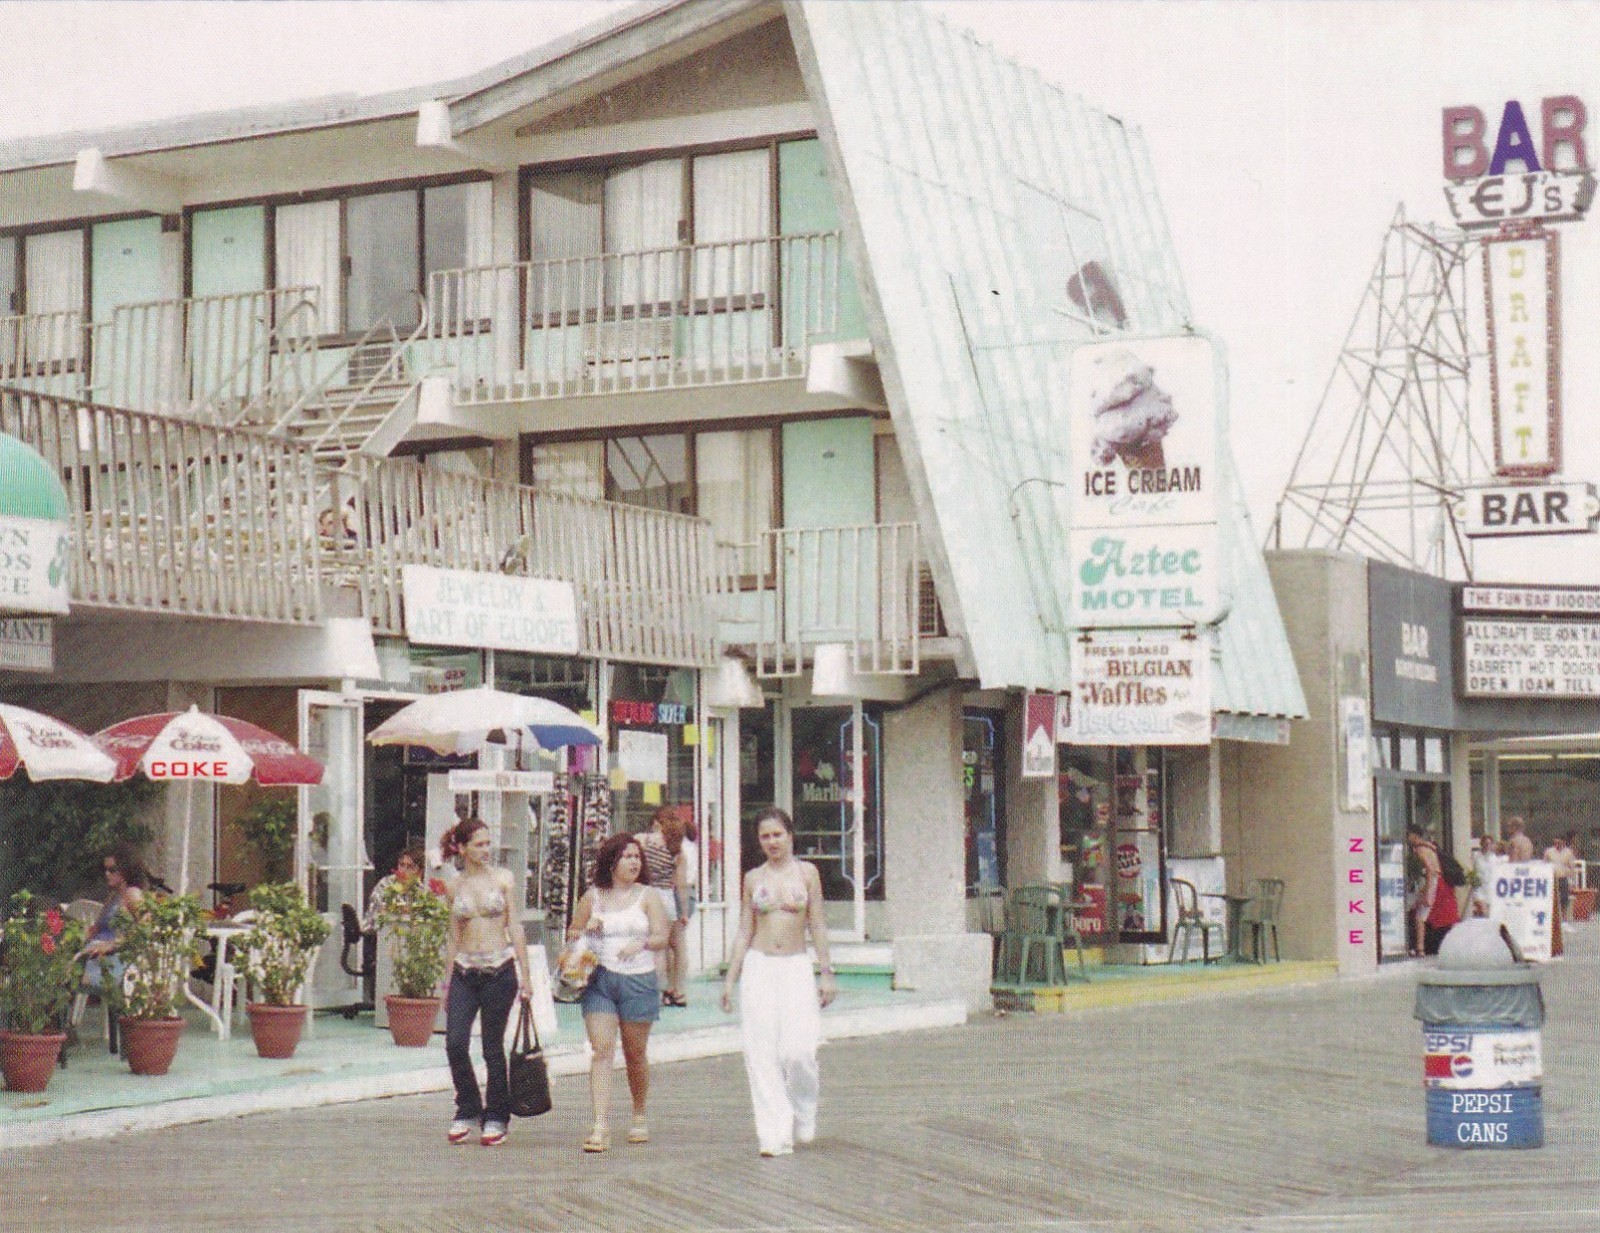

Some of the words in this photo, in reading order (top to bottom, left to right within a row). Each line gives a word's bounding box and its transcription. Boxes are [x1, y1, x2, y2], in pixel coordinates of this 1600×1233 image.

[1442, 95, 1588, 180] BAR
[1507, 247, 1533, 459] DRAFT
[1084, 471, 1116, 496] ICE
[1127, 467, 1201, 495] CREAM
[1482, 490, 1570, 527] BAR
[1079, 537, 1201, 586] Aztec
[1081, 587, 1203, 610] MOTEL
[1469, 591, 1491, 605] THE
[415, 608, 455, 638] ART
[466, 612, 489, 639] OF
[500, 615, 573, 648] EUROPE
[1083, 646, 1124, 657] FRESH
[1128, 645, 1169, 656] BAKED
[1107, 660, 1192, 679] BELGIAN
[1077, 681, 1168, 707] Waffles
[1470, 677, 1508, 691] OPEN
[1496, 878, 1548, 898] OPEN
[1424, 1034, 1473, 1052] EPSI
